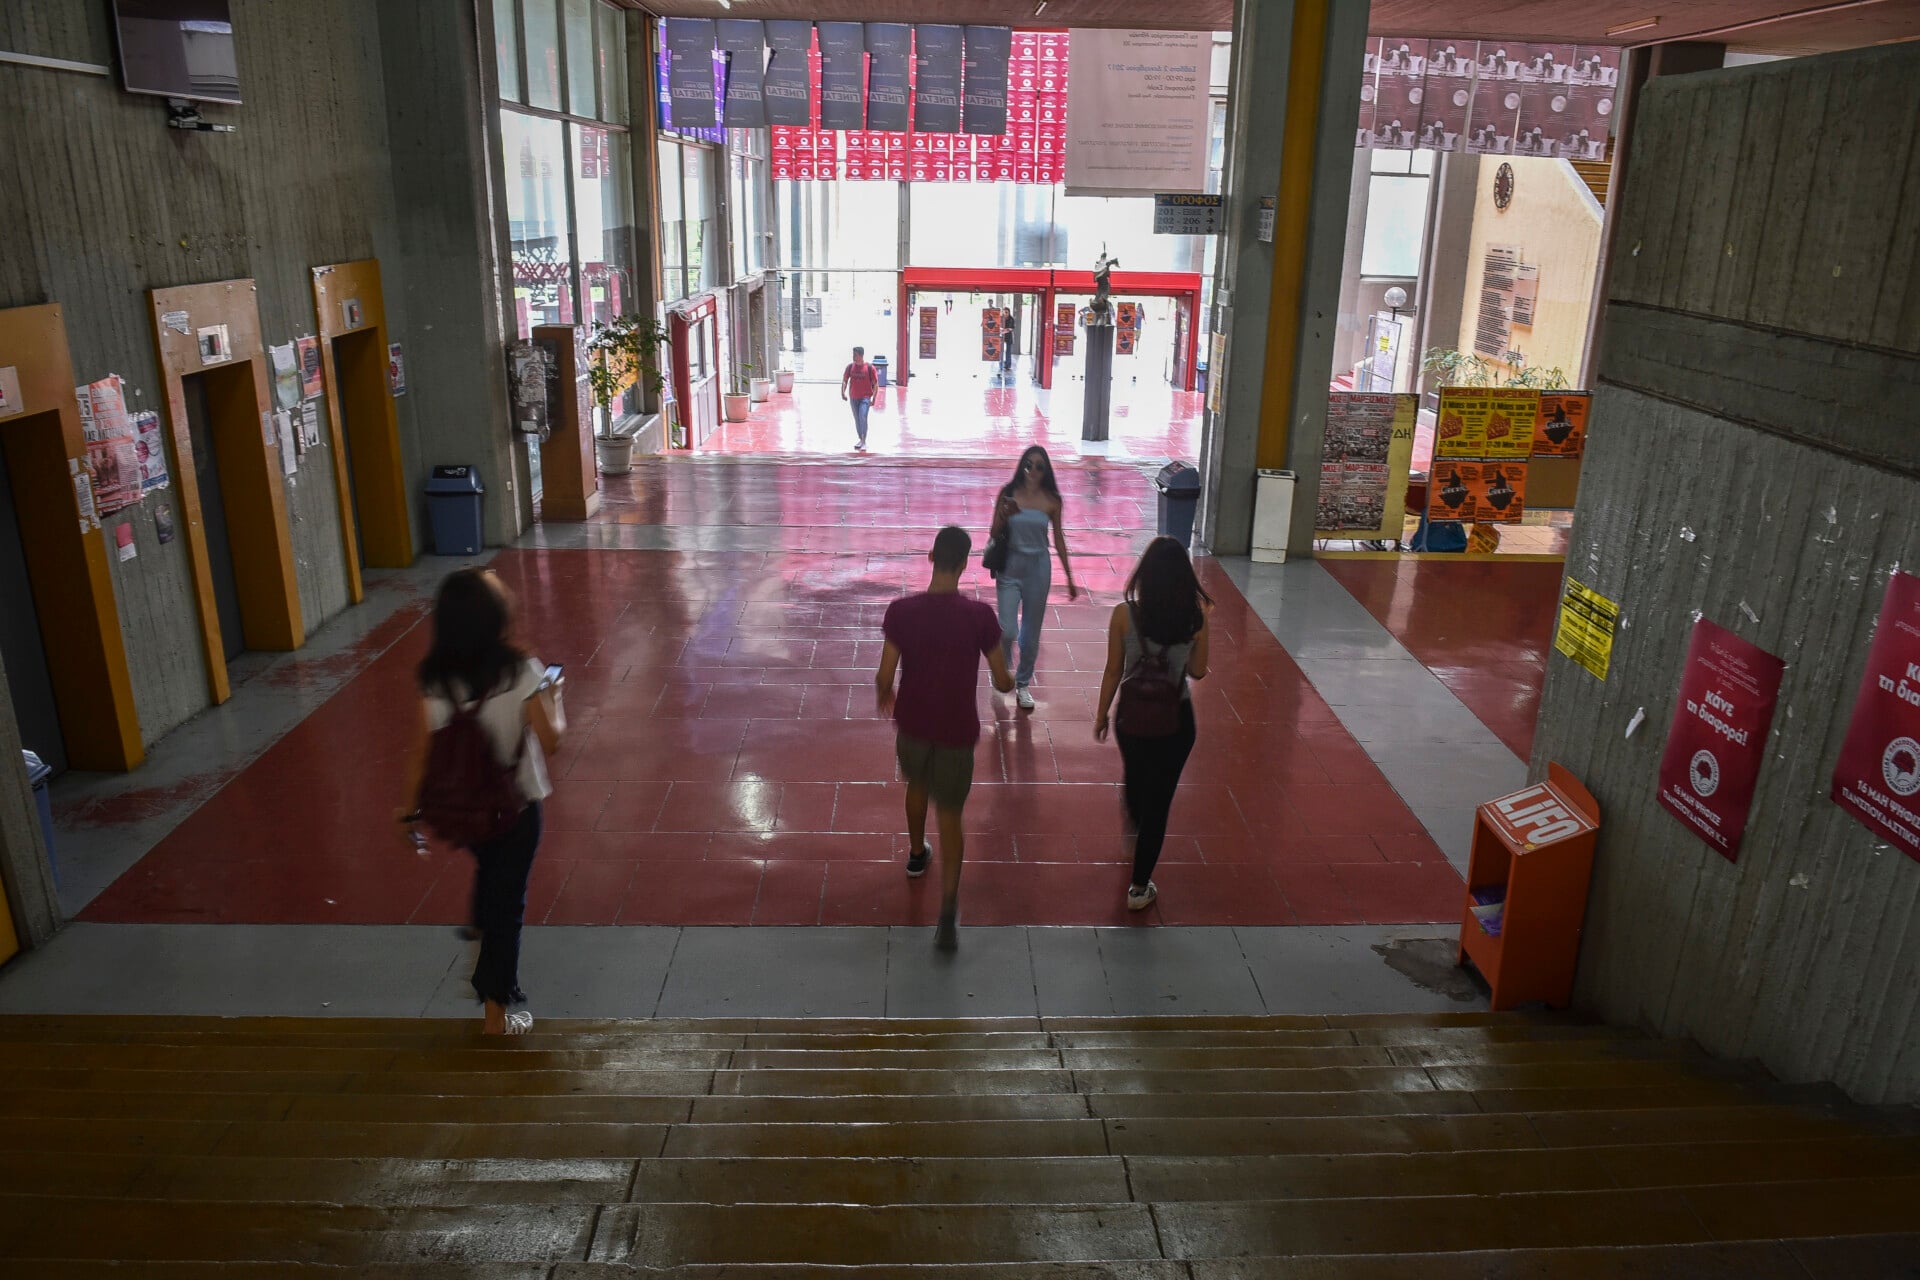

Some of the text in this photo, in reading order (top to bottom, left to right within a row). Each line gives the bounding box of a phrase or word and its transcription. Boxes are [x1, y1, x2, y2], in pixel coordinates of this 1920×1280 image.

[1173, 195, 1219, 205] ΟΡΟΦΟΣ
[1157, 208, 1175, 216] 201
[1157, 217, 1175, 225] 202
[1183, 217, 1201, 225] 206
[1879, 674, 1894, 693] τη
[1705, 689, 1735, 717] κάνε
[1687, 699, 1748, 747] τη διαφορά!
[1858, 780, 1869, 794] 16
